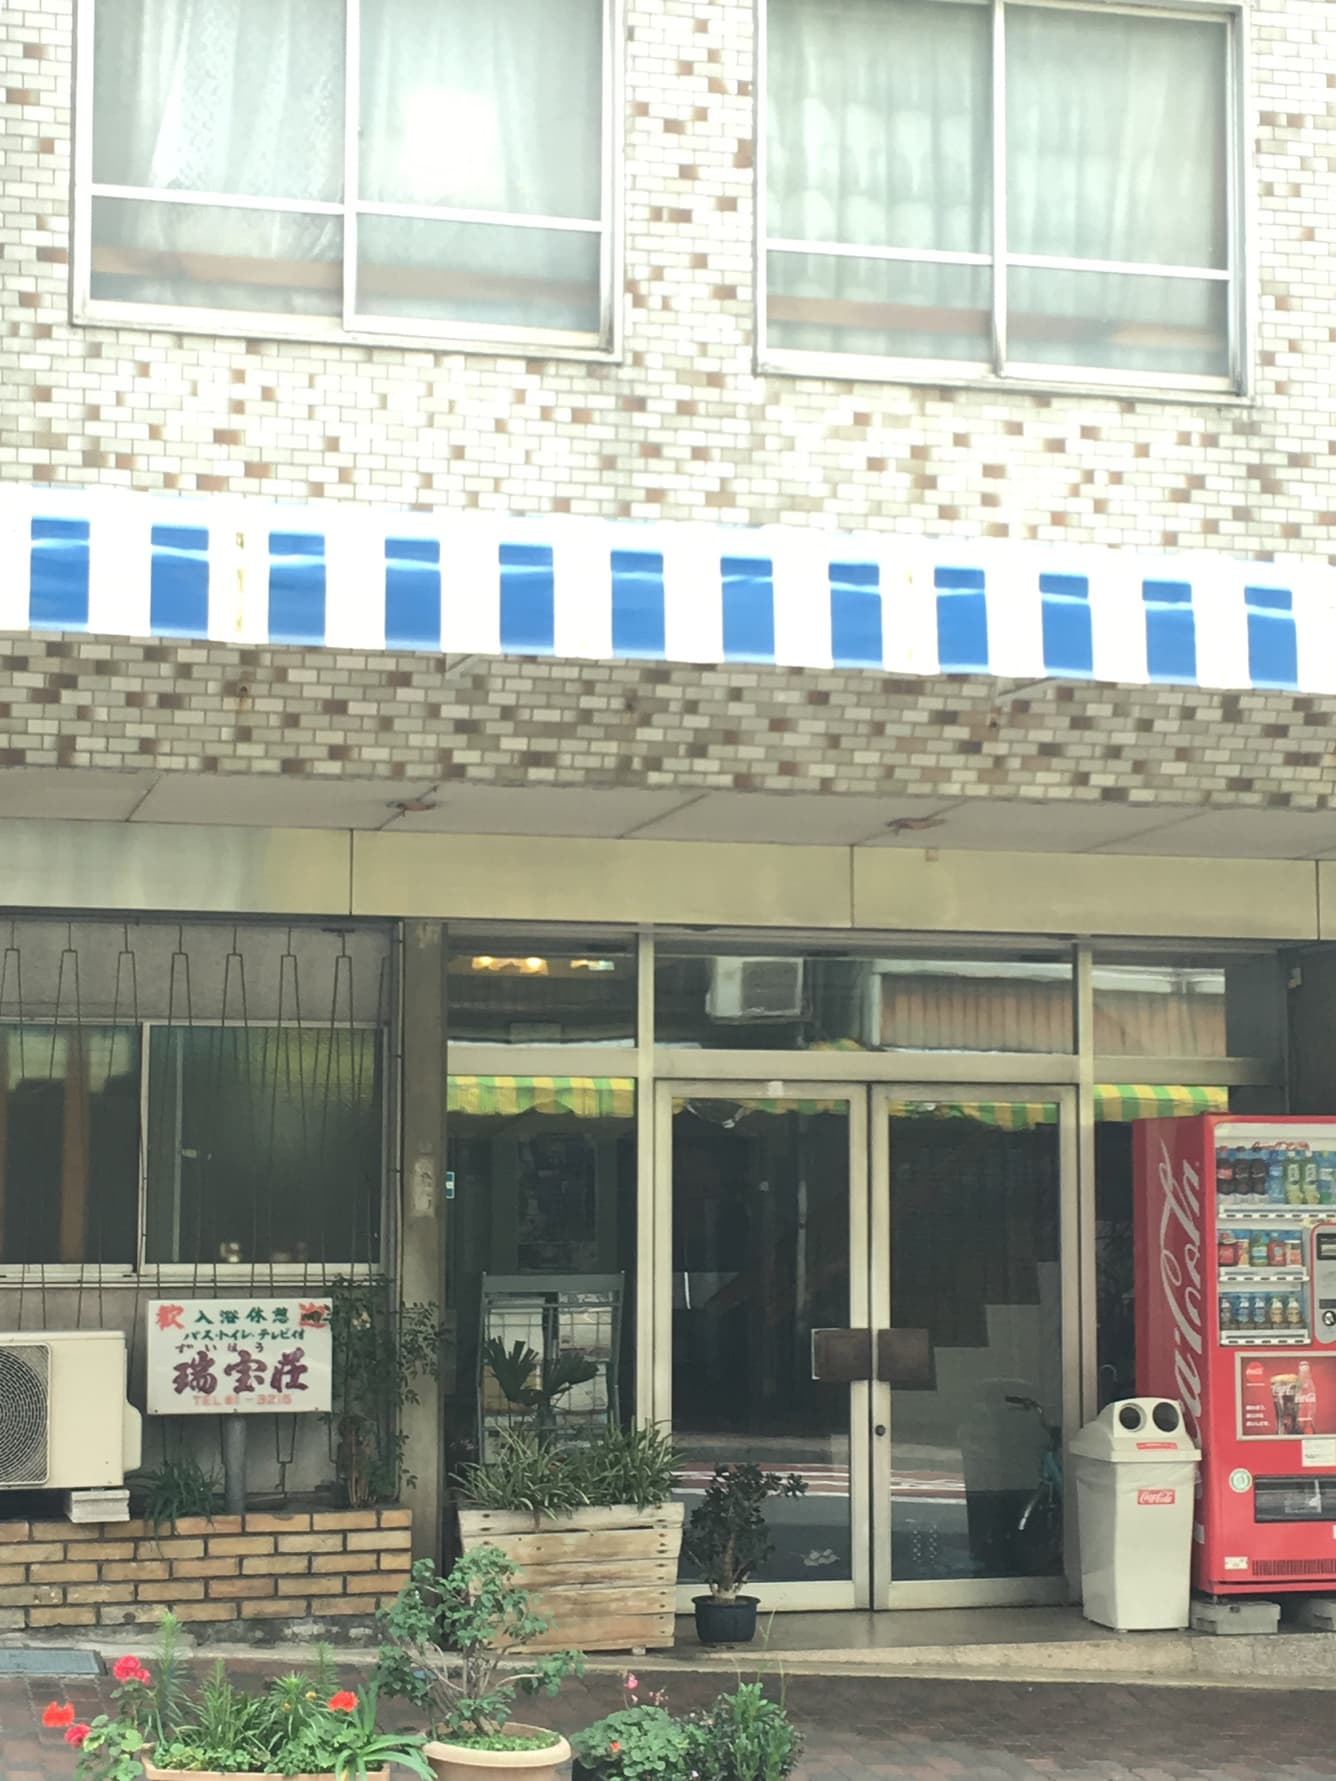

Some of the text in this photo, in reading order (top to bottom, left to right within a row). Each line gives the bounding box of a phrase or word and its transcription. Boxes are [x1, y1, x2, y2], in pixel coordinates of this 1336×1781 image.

[156, 1304, 185, 1330] 歓
[194, 1306, 290, 1325] 入浴休憩
[172, 1346, 309, 1395] 瑞宝荘
